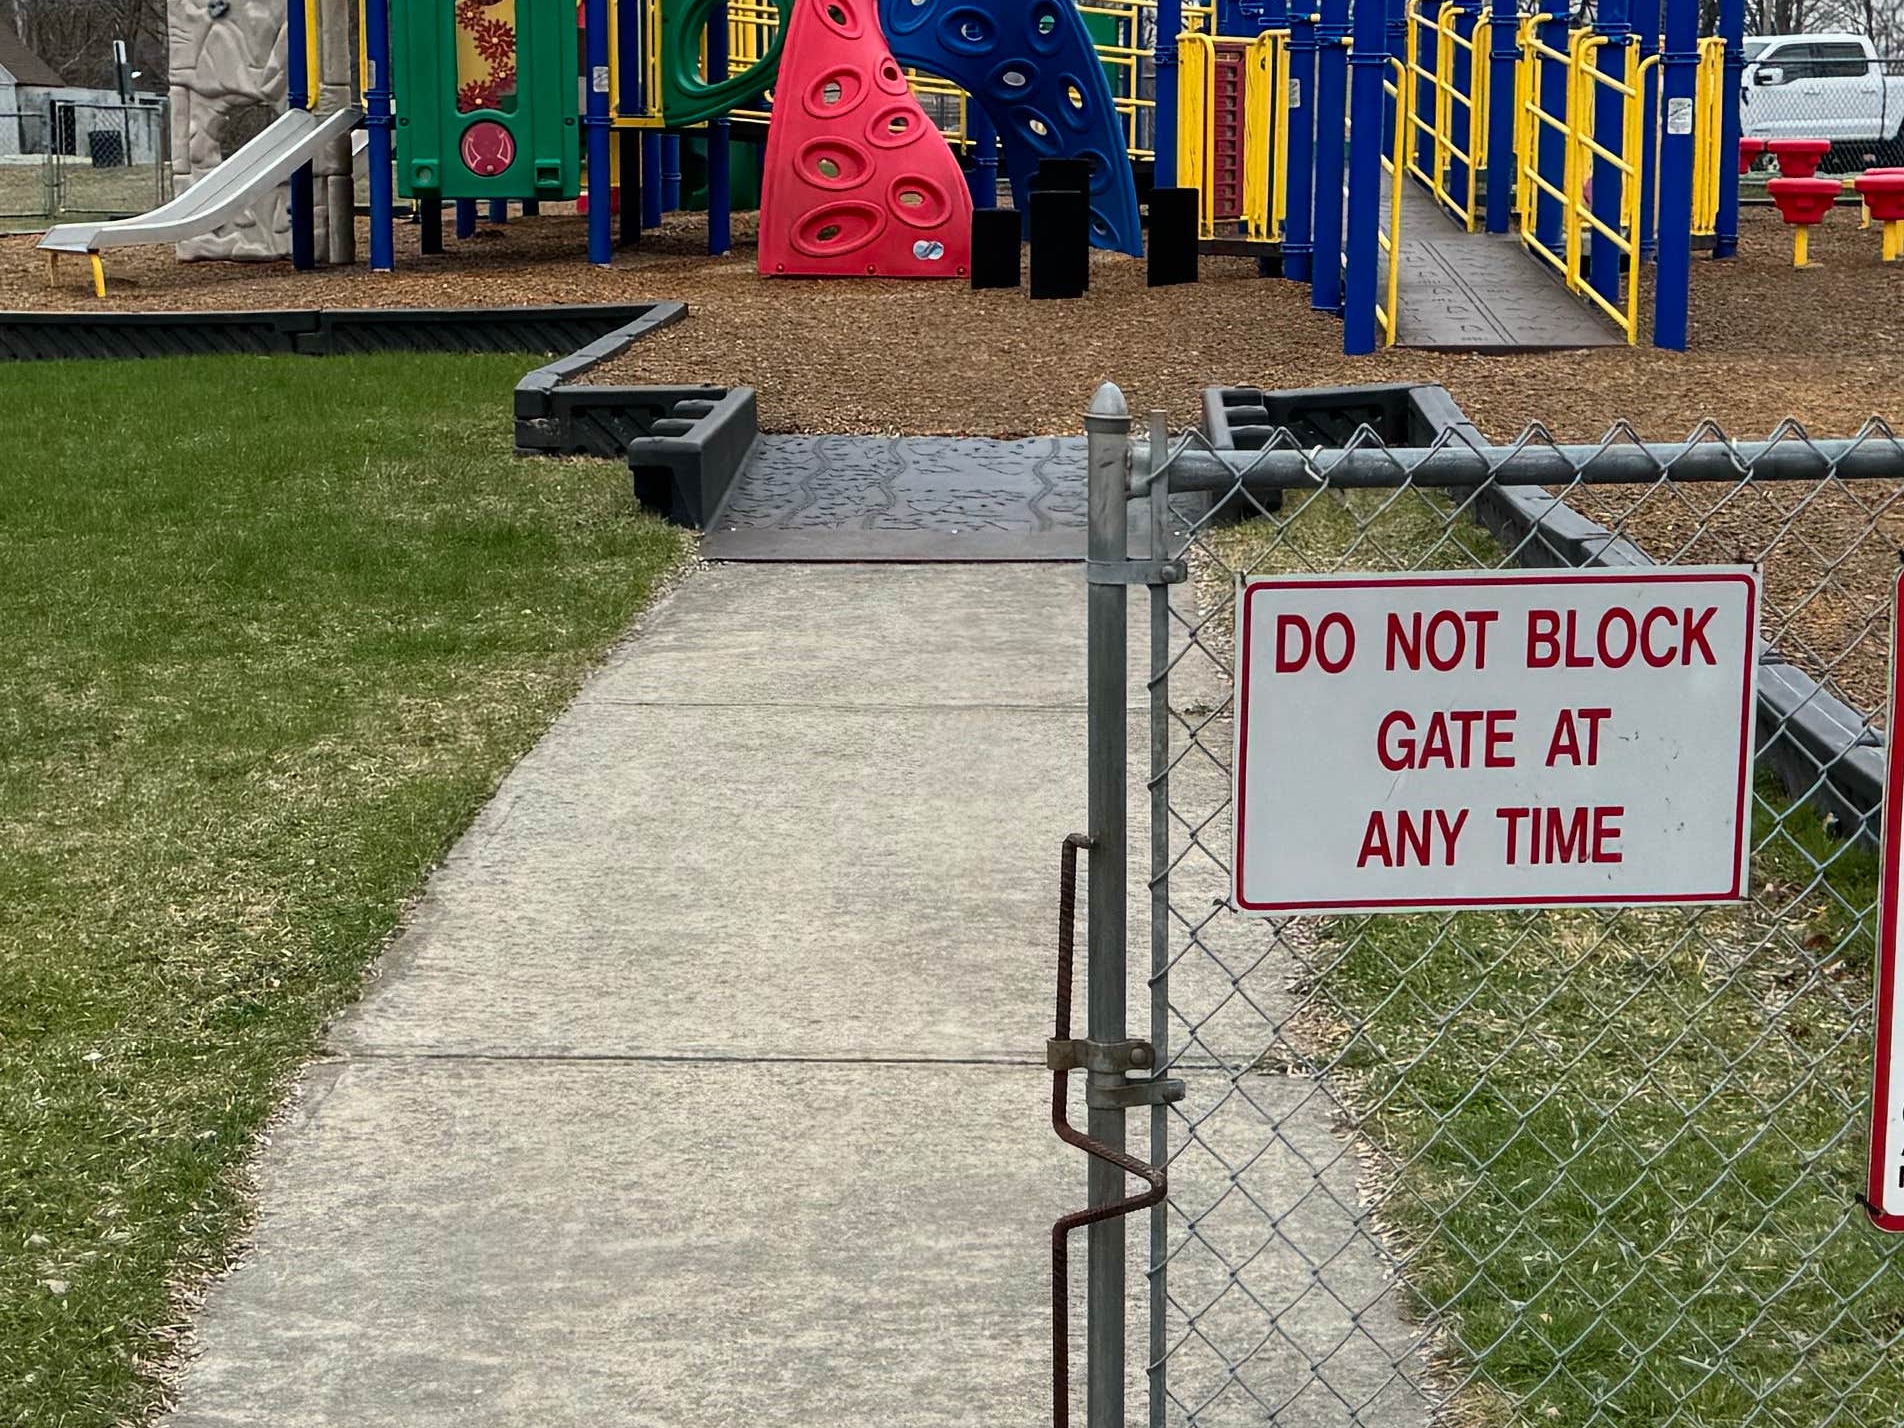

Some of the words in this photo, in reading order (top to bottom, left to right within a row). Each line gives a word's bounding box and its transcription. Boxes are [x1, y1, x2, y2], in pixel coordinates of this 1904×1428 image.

[1276, 613, 1354, 672] DO
[1387, 611, 1497, 670] NOT
[1527, 607, 1716, 668] BLOCK
[1378, 710, 1515, 770] GATE
[1547, 709, 1611, 766] AT
[1359, 810, 1467, 866] ANY
[1497, 807, 1623, 863] TIME
